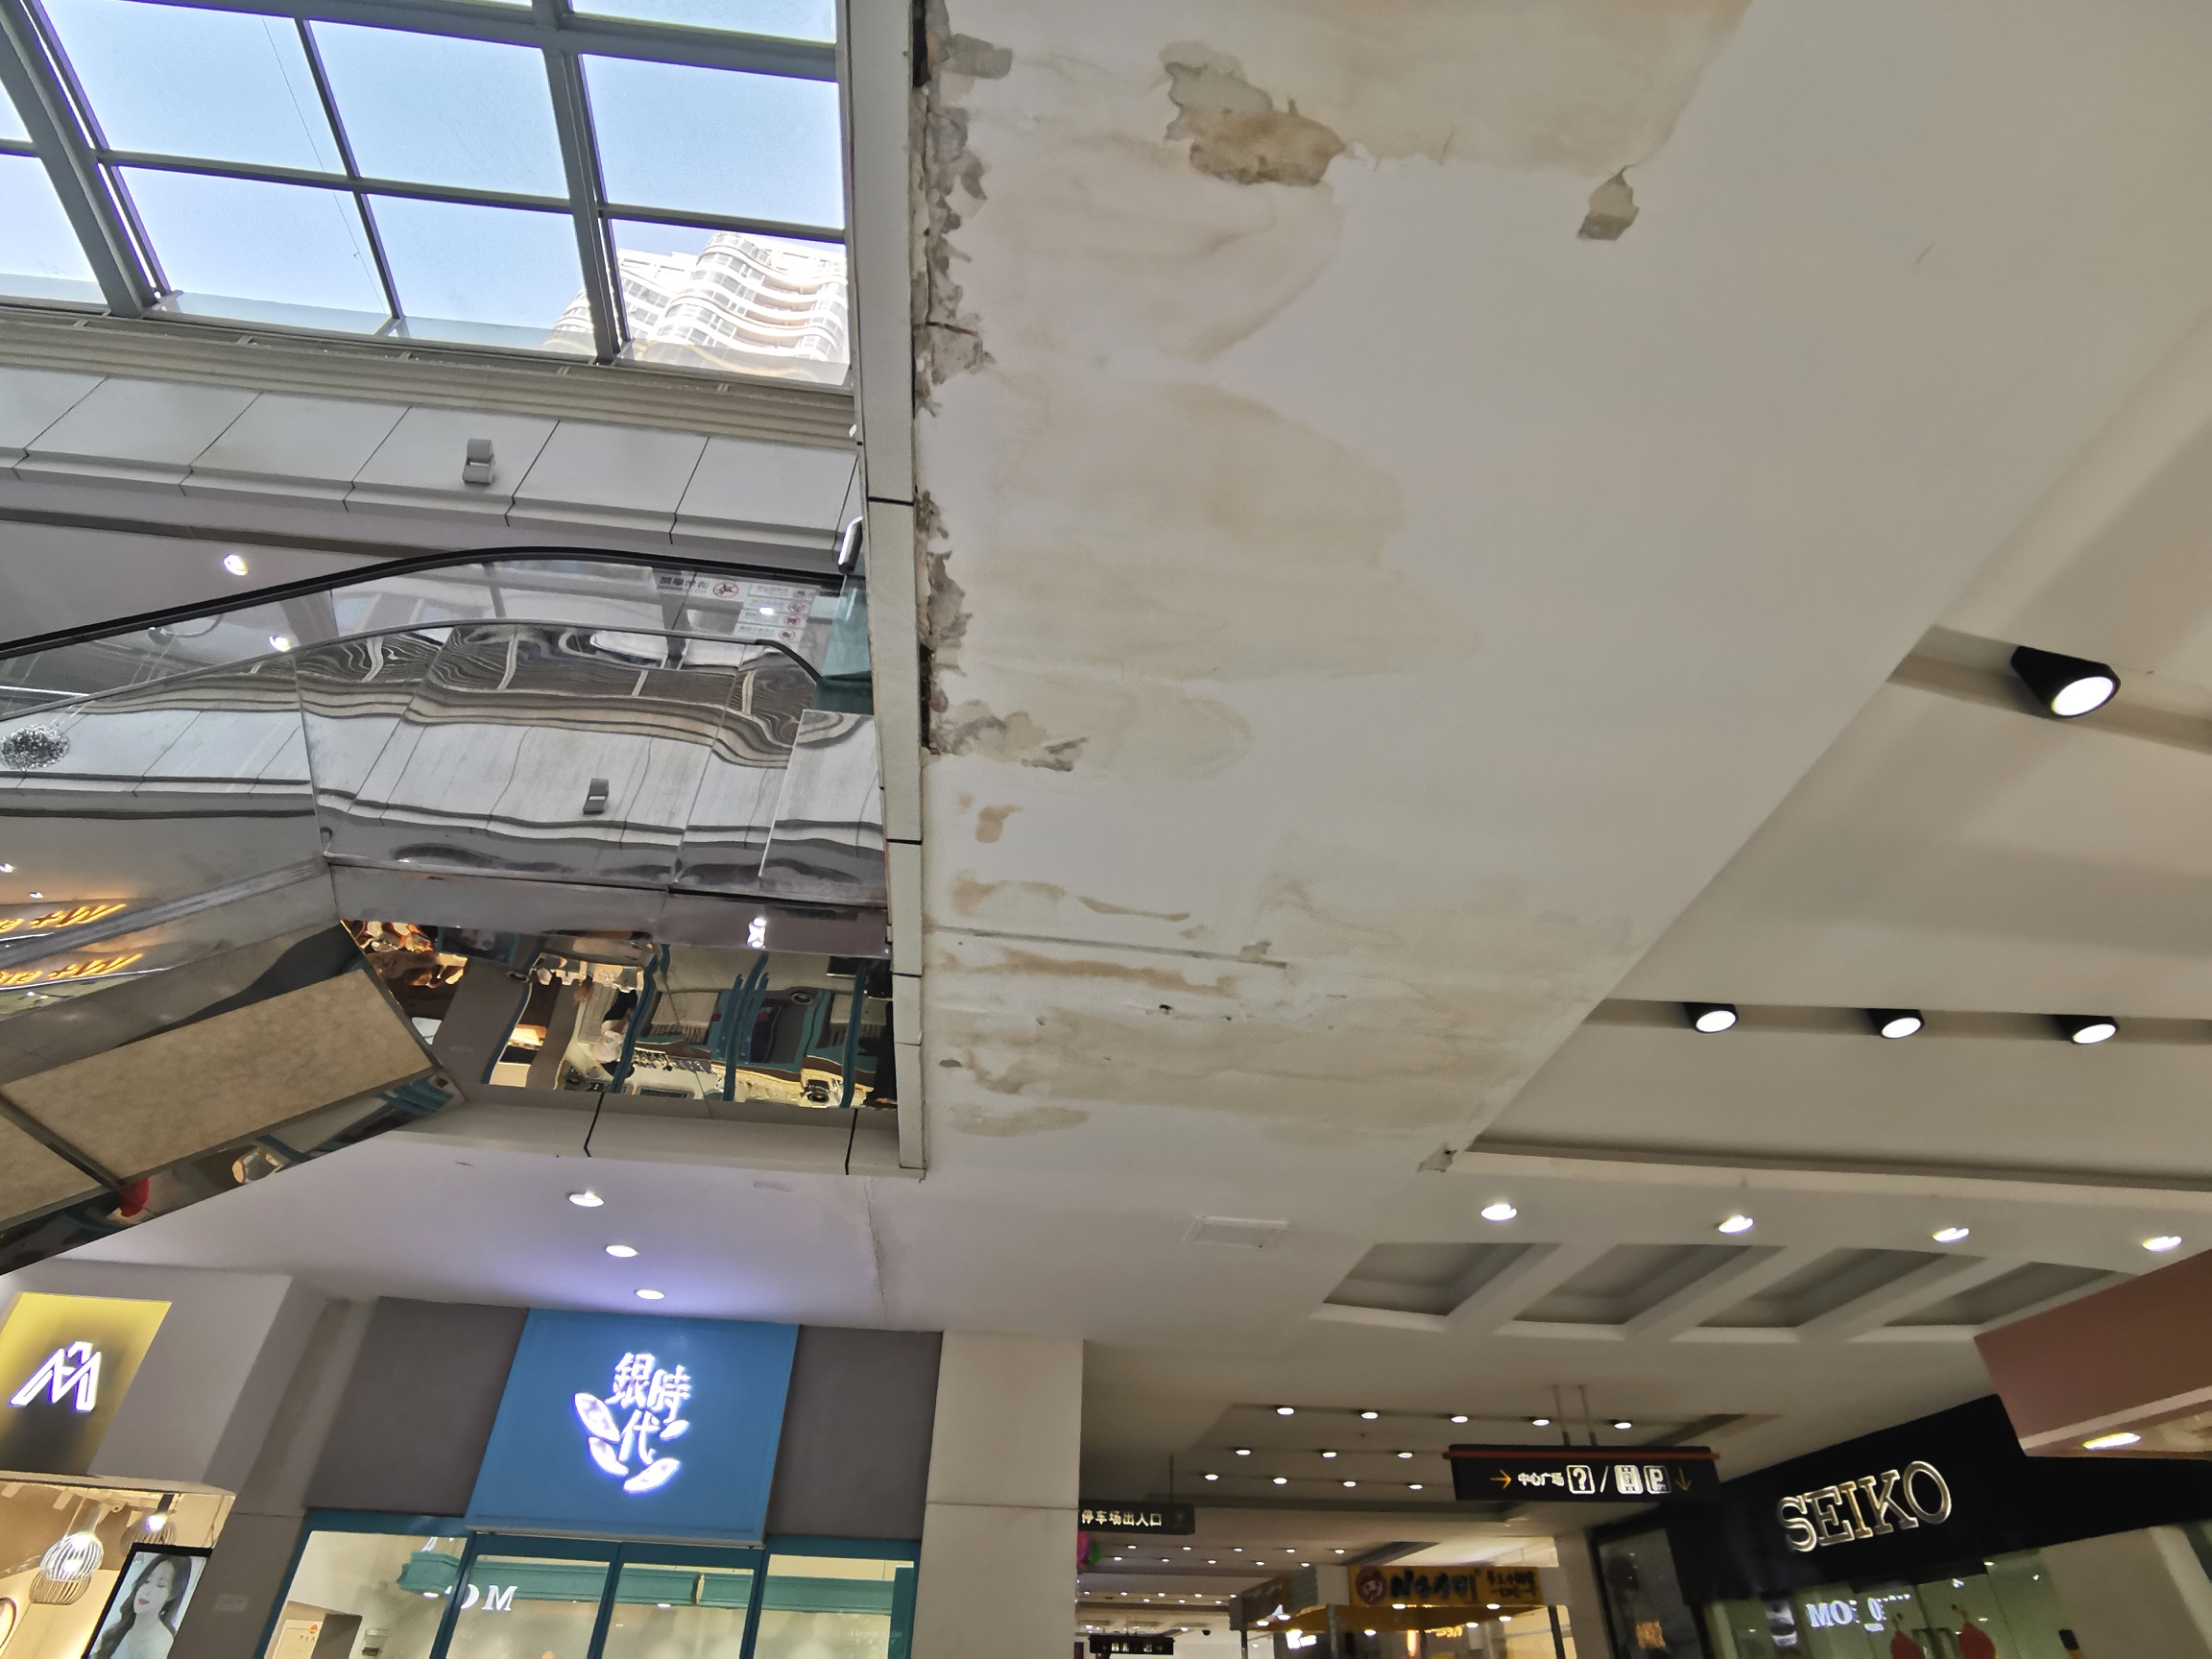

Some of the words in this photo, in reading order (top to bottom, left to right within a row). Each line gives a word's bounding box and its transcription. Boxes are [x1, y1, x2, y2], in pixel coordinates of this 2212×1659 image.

[1081, 1509, 1163, 1527] 停车场出入口
[1777, 1460, 1953, 1552] SEIKO
